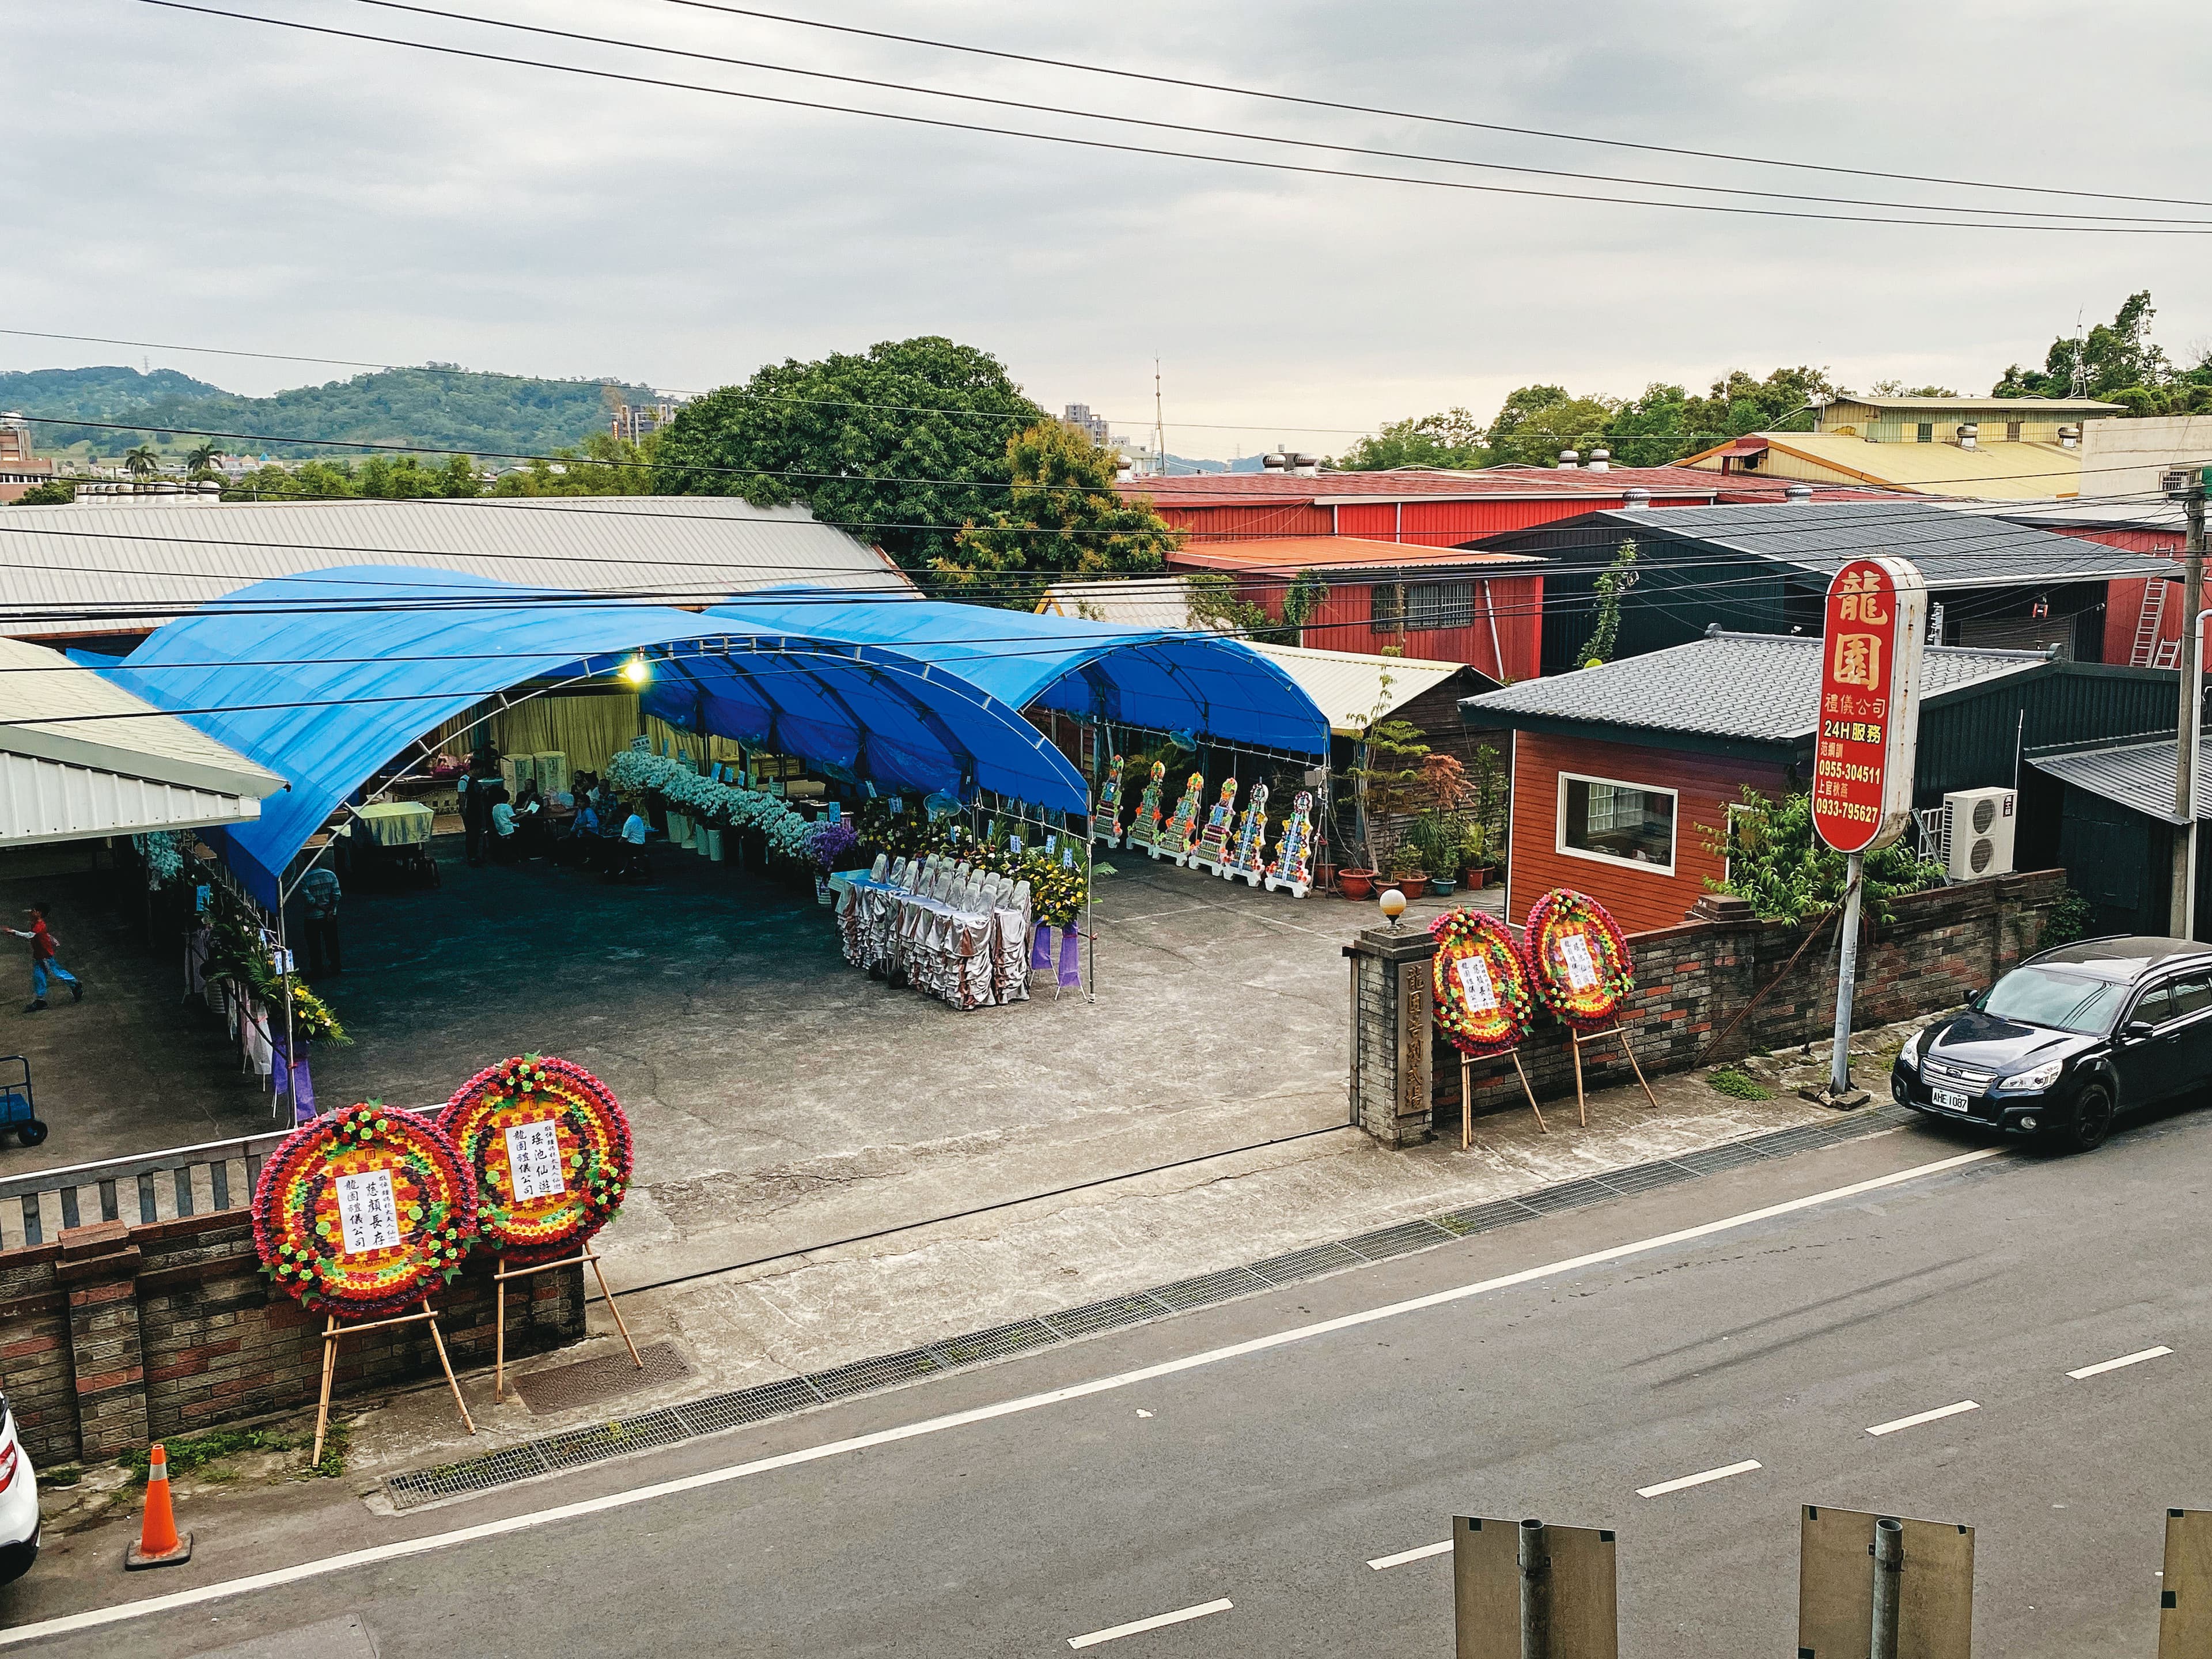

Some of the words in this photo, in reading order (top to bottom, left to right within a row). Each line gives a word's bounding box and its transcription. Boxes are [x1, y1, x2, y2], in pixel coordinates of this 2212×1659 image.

[1834, 570, 1888, 691] 龍園
[1824, 693, 1885, 719] 禮儀公司
[1824, 719, 1881, 744] 24H服務
[1819, 759, 1880, 785] 0955-304511
[1816, 797, 1878, 823] 0933-795627
[513, 1130, 533, 1195] 龍園禮儀公司
[344, 1180, 365, 1248] 龍園禮儀公司
[366, 1181, 385, 1246] 慈顏長存
